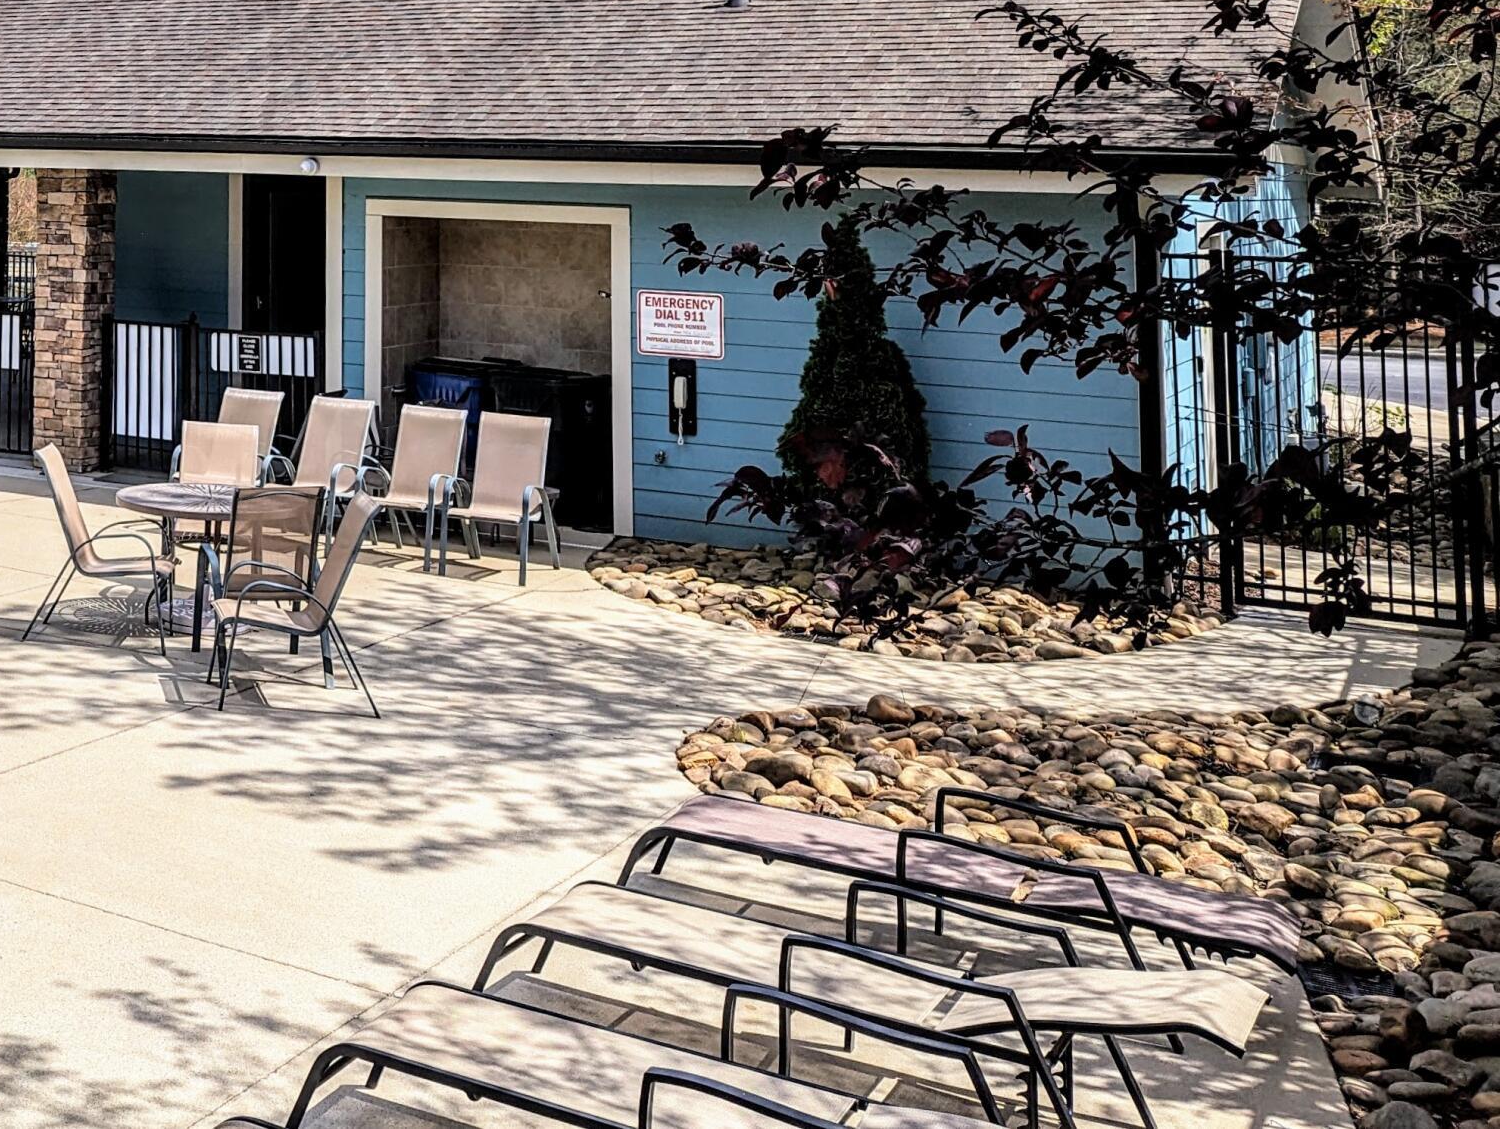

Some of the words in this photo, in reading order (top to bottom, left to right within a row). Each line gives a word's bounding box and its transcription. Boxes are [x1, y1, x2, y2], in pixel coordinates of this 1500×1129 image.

[645, 296, 715, 311] EMERGENCY
[655, 309, 680, 321] DIAL
[684, 311, 705, 322] 911
